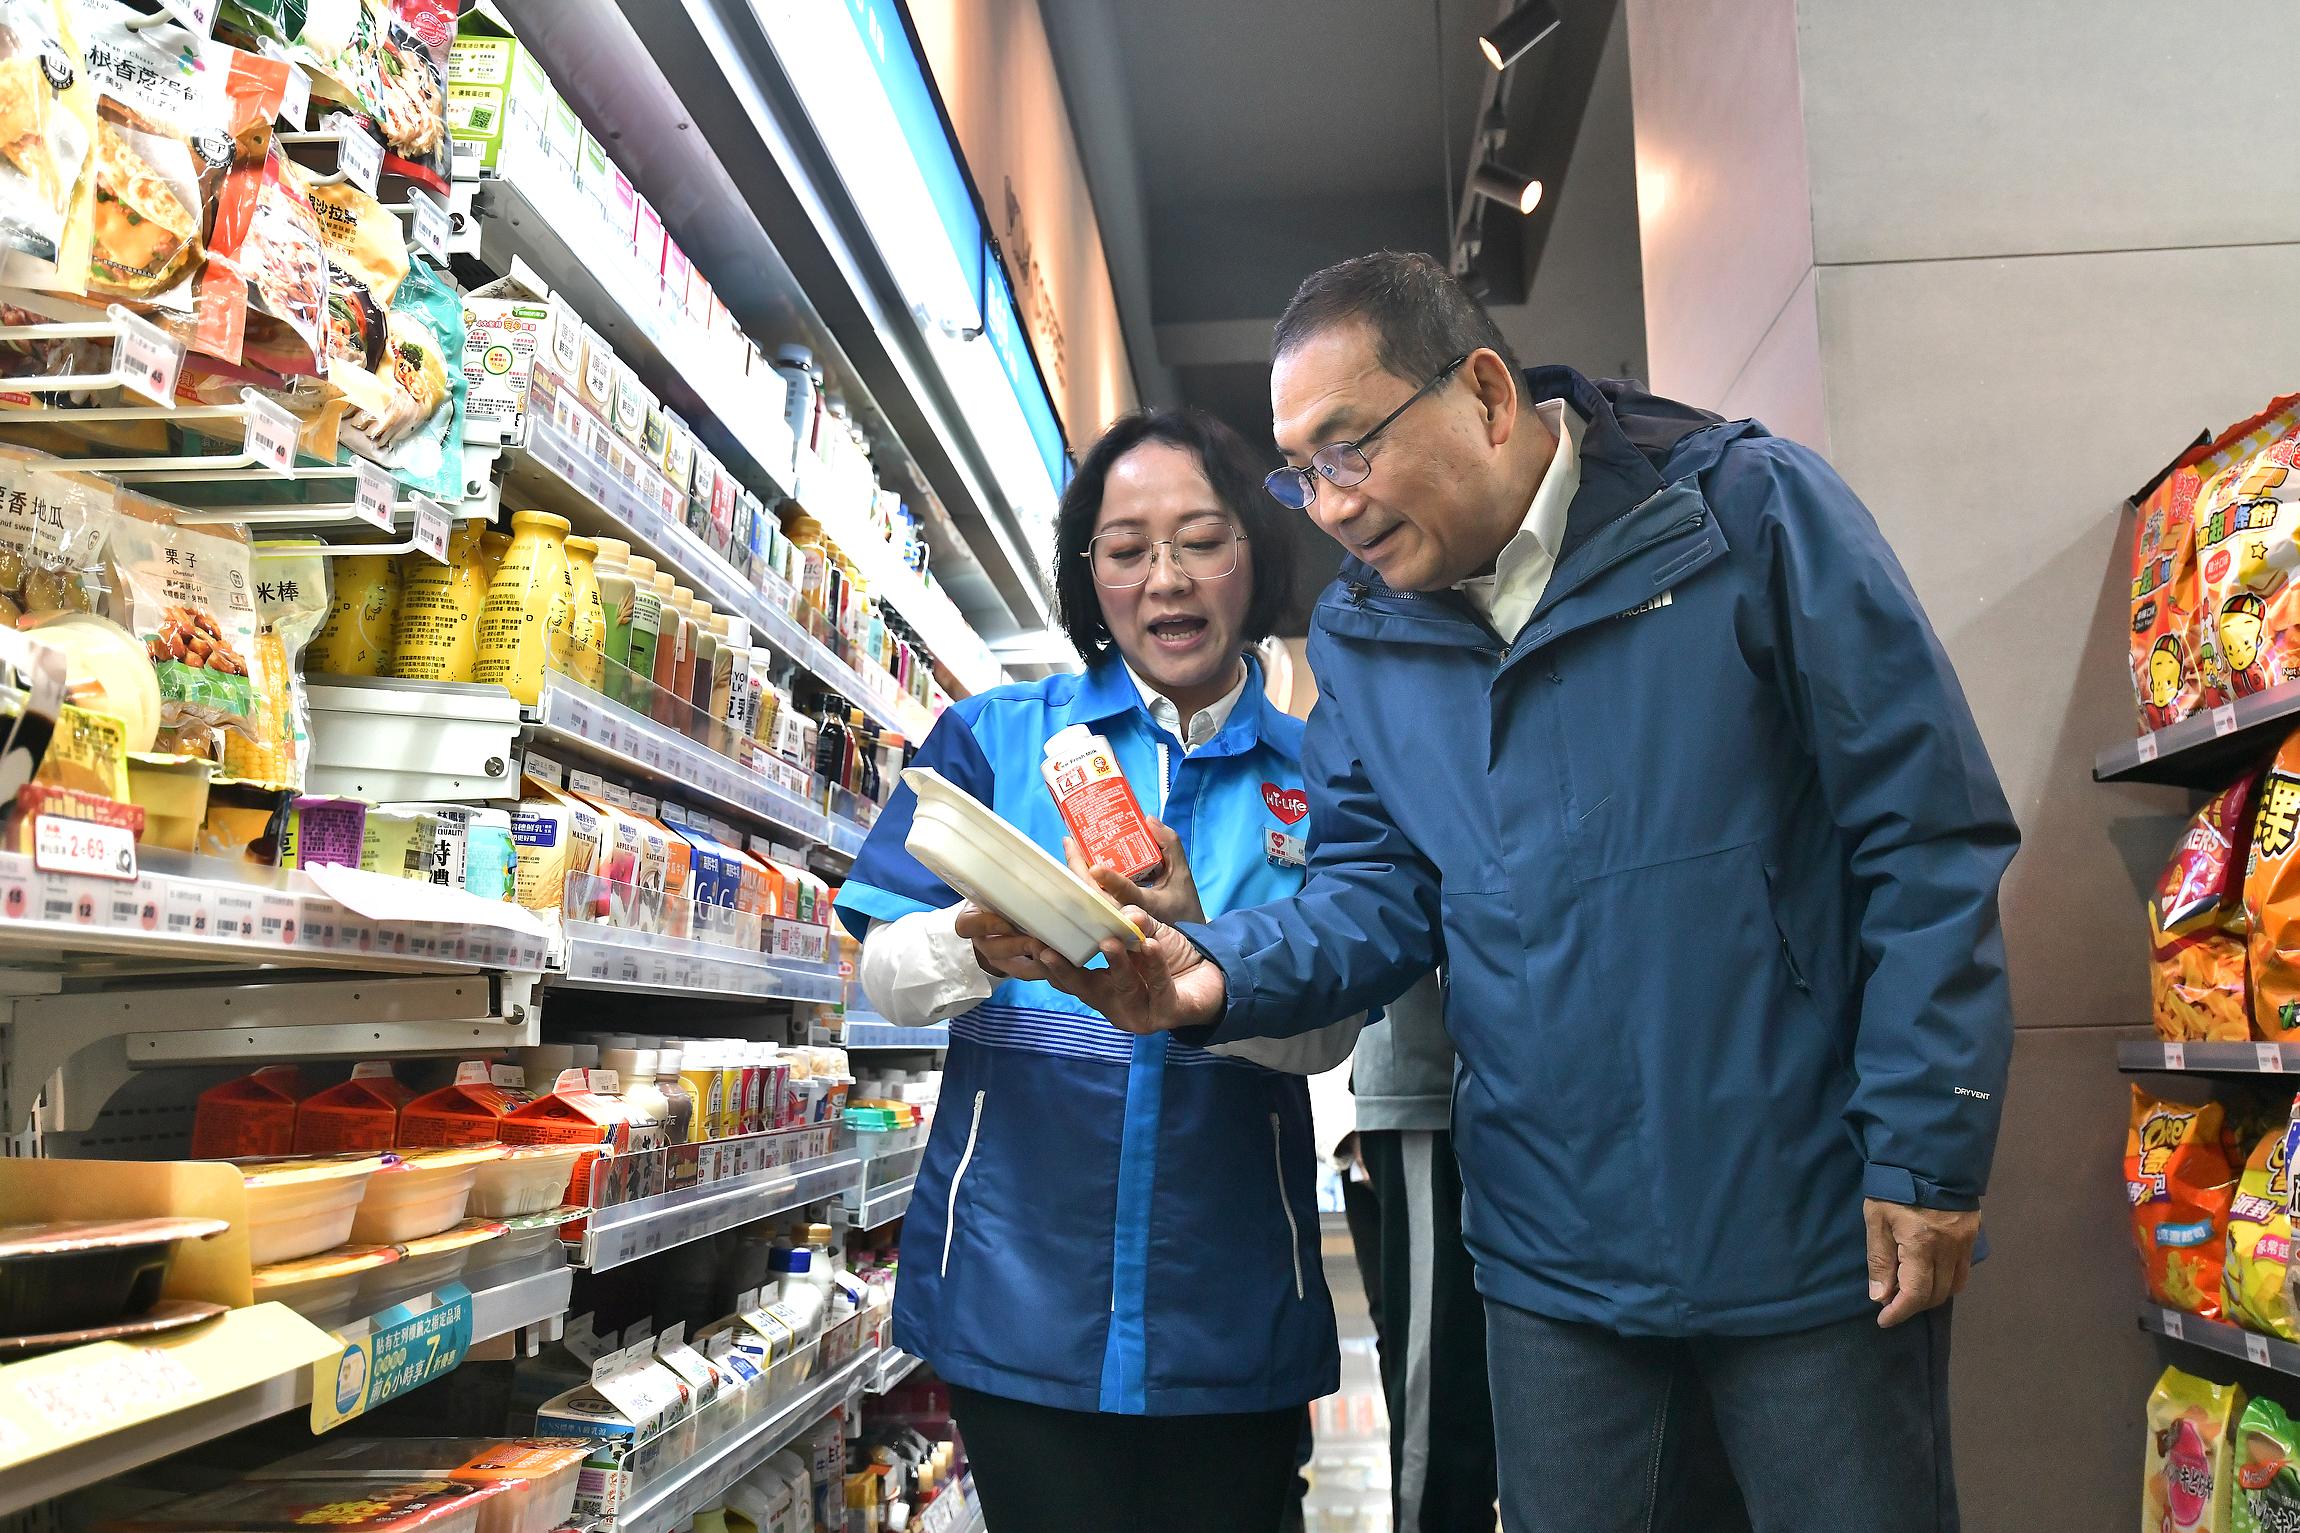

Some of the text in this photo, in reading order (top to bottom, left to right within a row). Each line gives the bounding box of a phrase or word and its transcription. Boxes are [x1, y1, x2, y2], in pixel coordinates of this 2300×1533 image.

[164, 547, 198, 569] 栗子
[437, 828, 464, 837] QUALITY
[615, 841, 630, 853] APPLE
[1953, 1086, 1991, 1100] DRYVENT
